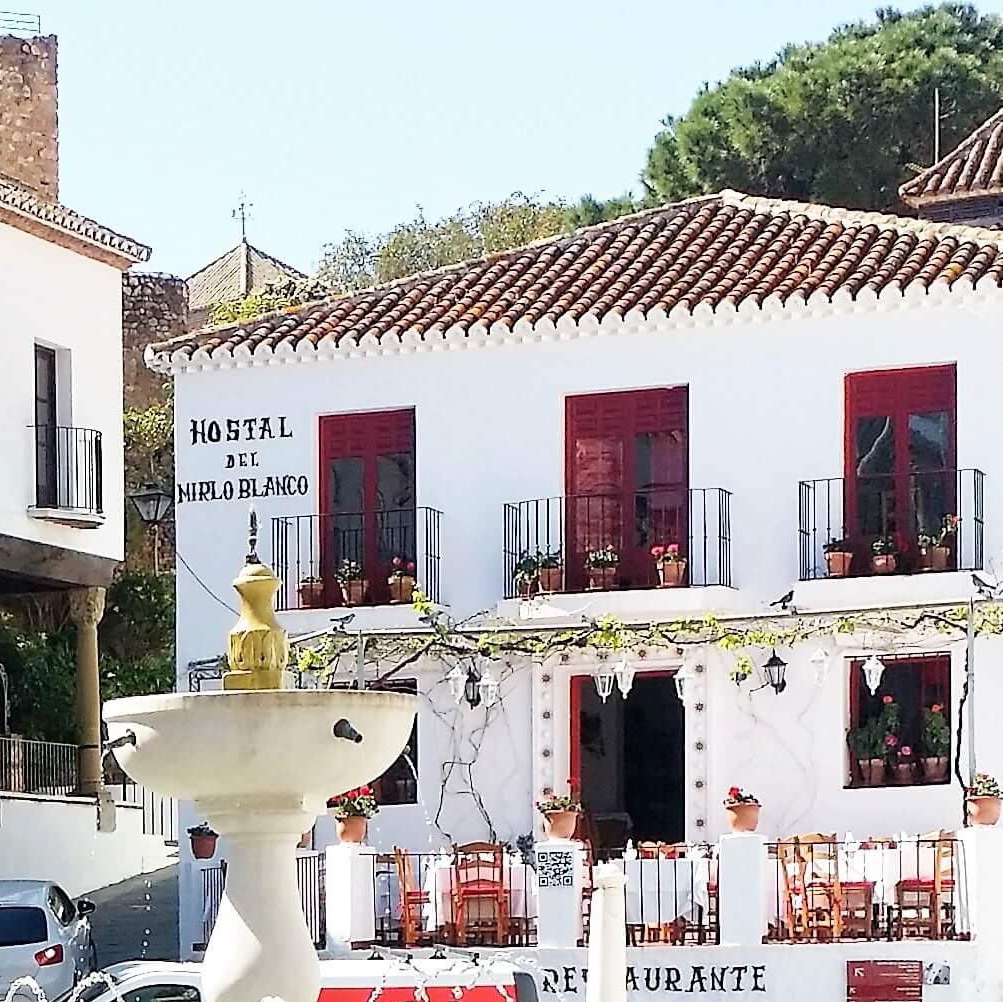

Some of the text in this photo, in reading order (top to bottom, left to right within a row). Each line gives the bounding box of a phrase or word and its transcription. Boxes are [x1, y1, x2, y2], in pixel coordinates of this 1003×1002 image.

[190, 417, 293, 445] HOSTAL
[225, 451, 260, 469] DEL
[237, 474, 310, 500] BLANCO
[542, 965, 766, 993] REAURANTE
